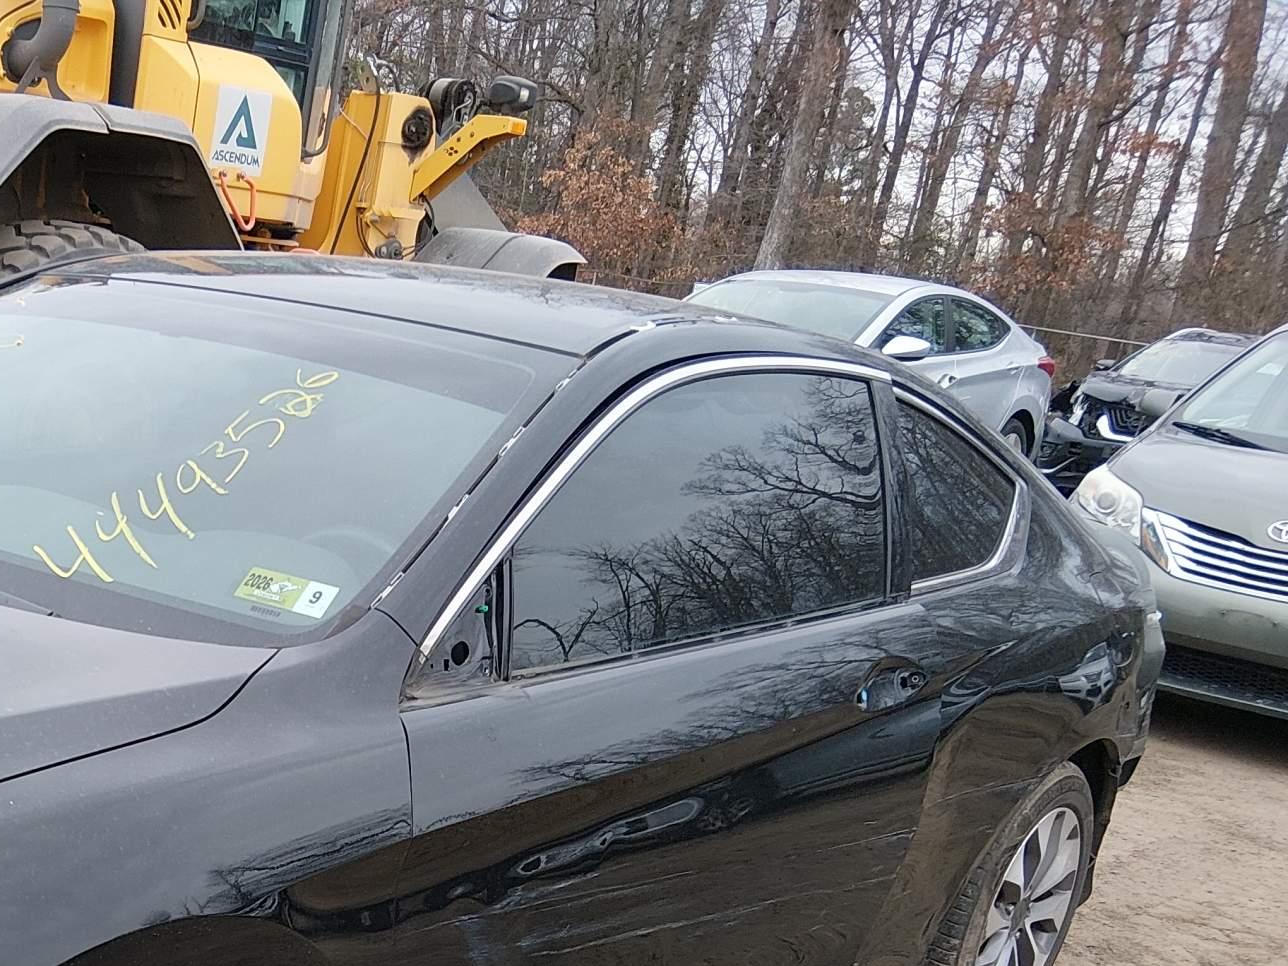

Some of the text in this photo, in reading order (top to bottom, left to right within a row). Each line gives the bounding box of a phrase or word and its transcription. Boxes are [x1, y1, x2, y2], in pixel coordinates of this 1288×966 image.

[212, 149, 260, 168] ASCENDUM
[243, 573, 323, 604] 2026 9
